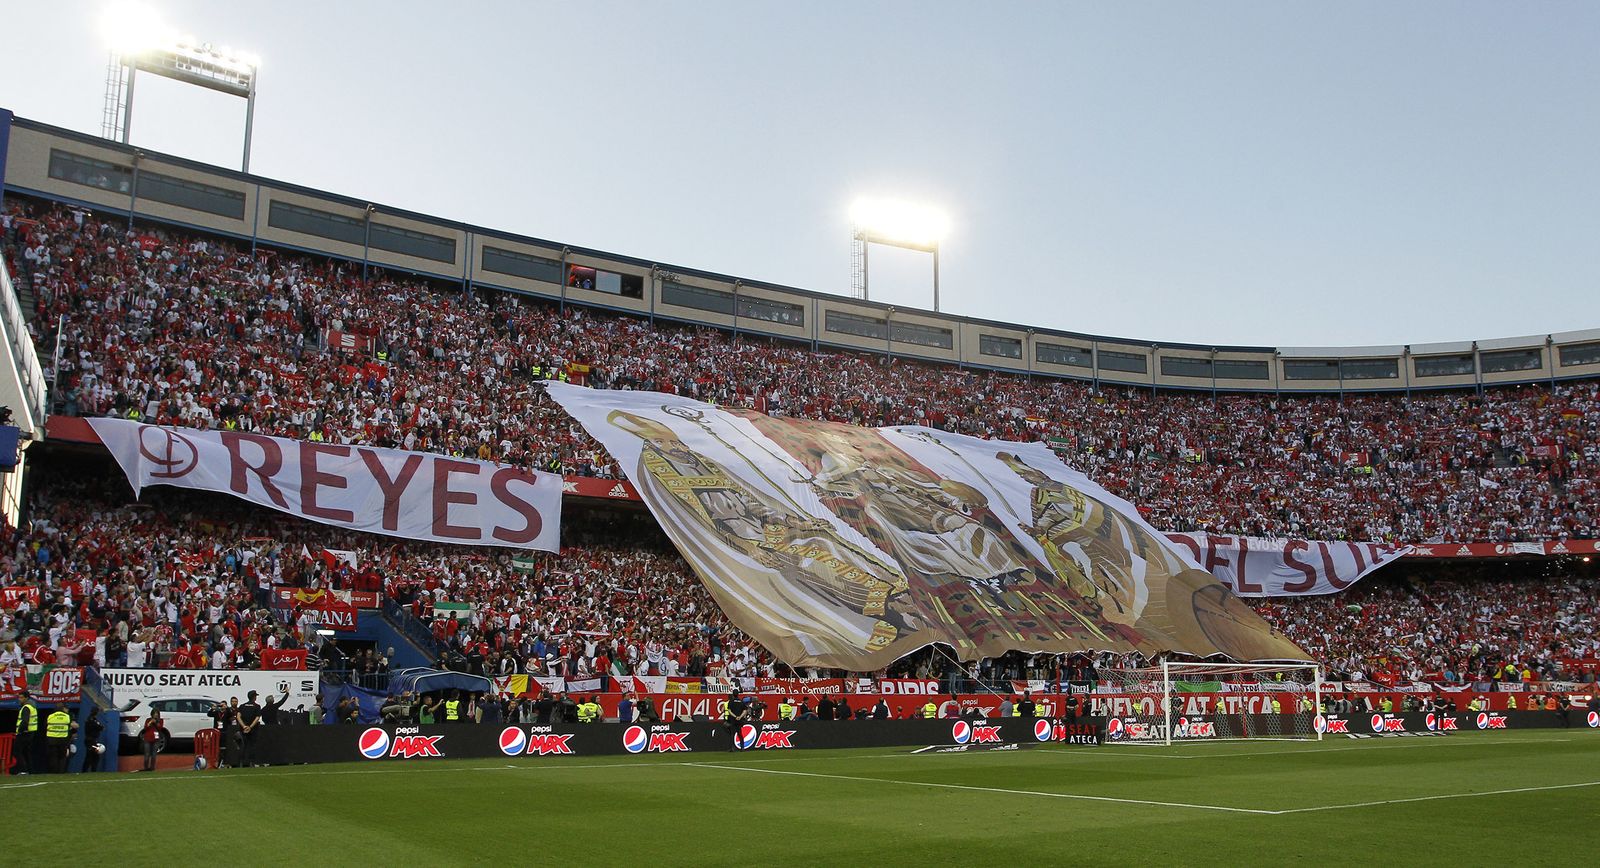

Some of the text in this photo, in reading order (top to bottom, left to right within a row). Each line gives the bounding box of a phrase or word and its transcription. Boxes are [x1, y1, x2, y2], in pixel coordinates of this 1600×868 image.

[220, 430, 542, 543] REYES
[48, 671, 81, 694] 1905
[103, 673, 241, 687] NUEVO SEAT ATECA
[776, 684, 785, 694] de
[962, 698, 978, 706] pepsi
[662, 698, 714, 720] FINAL
[651, 724, 670, 733] pepsi
[762, 723, 780, 731] pepsi
[1326, 719, 1349, 733] MAX
[1384, 718, 1406, 731] MAX
[1487, 716, 1507, 729] MAX
[395, 725, 419, 735] pepsi
[531, 725, 552, 734] pepsi
[970, 726, 1002, 743] MAX
[1070, 725, 1097, 735] SEAT
[527, 733, 575, 757] MAX
[648, 731, 690, 753] MAX
[755, 730, 797, 750] MAX
[1070, 735, 1098, 744] ATECA
[389, 735, 445, 758] MAX
